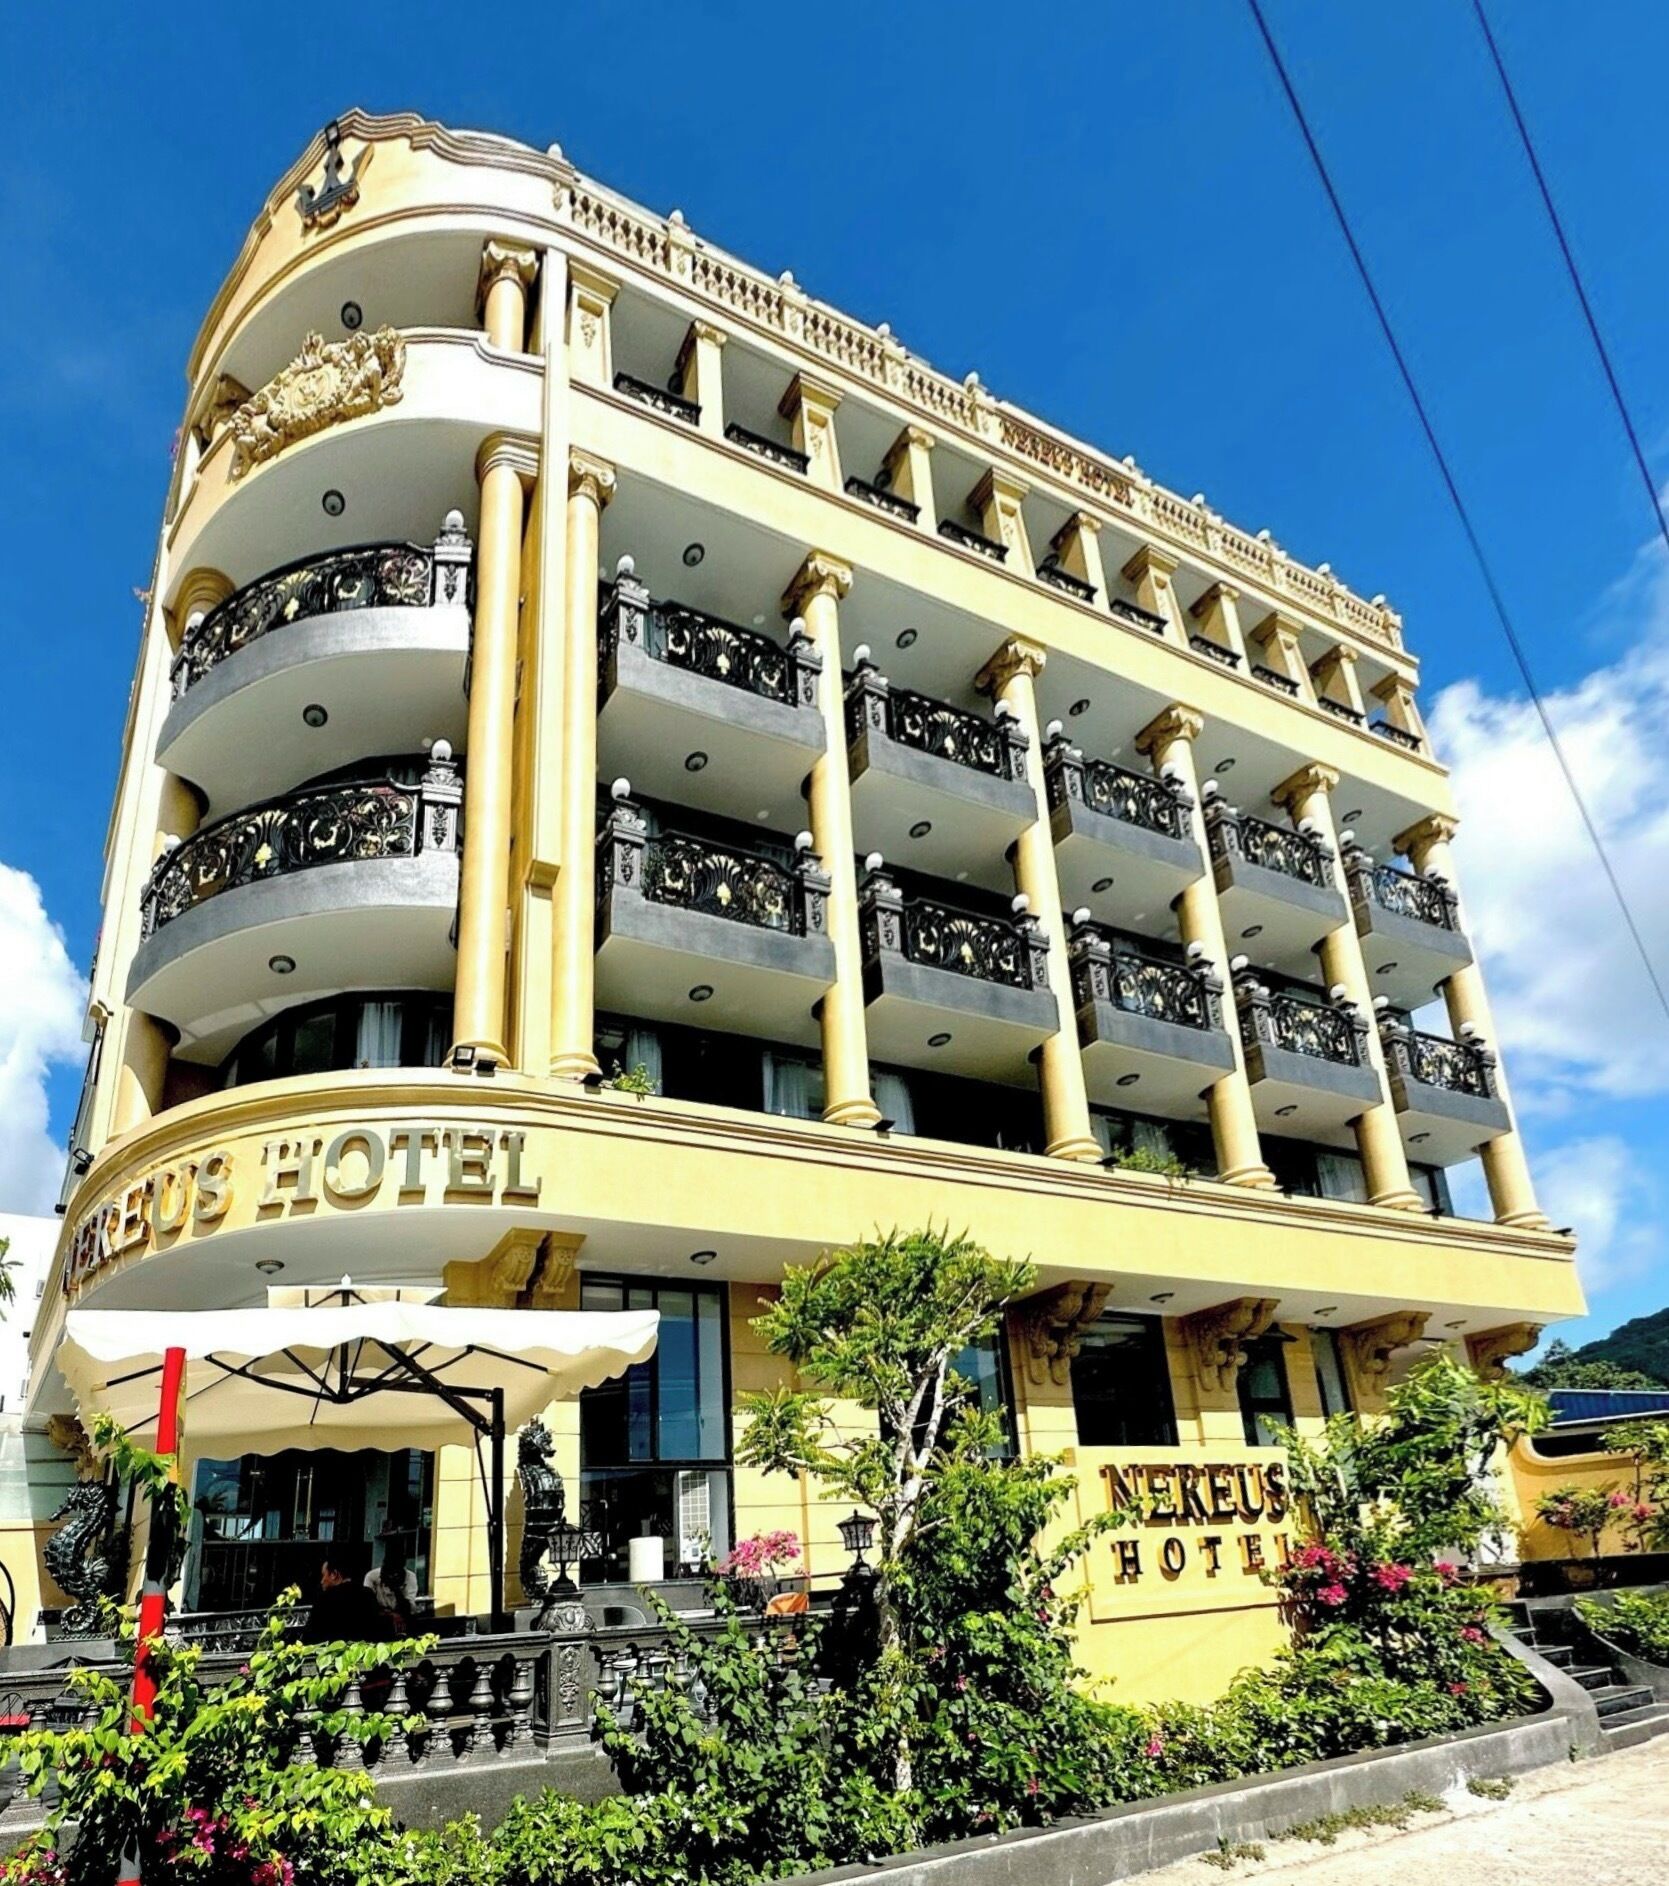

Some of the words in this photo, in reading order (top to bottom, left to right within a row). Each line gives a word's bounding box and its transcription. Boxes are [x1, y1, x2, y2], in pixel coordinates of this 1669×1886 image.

[62, 1150, 234, 1295] NEREUS
[257, 1127, 541, 1214] HOTEL
[1099, 1462, 1289, 1527] NEREUS
